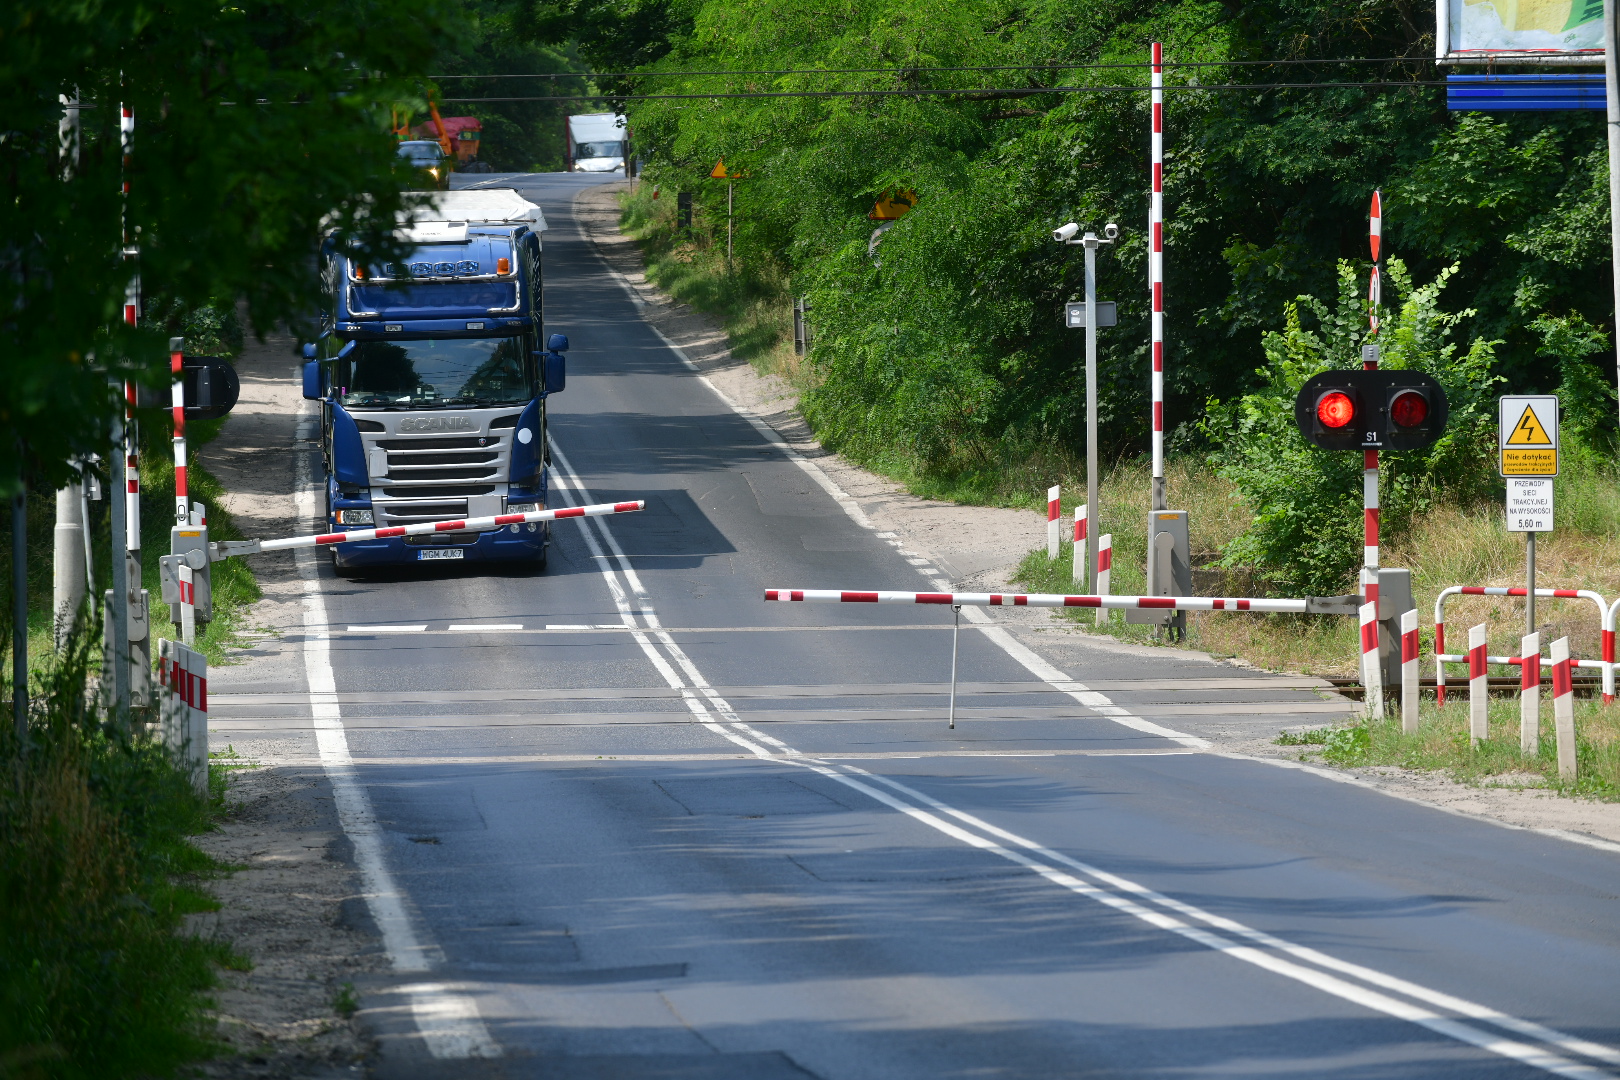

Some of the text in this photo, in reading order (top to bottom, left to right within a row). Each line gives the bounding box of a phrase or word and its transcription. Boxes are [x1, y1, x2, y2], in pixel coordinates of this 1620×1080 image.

[400, 416, 475, 432] SCANIA
[1366, 431, 1377, 442] S1
[1522, 453, 1552, 461] dotykać
[1517, 506, 1551, 515] WYSOKOŚCI
[1518, 518, 1543, 530] 5,60 m
